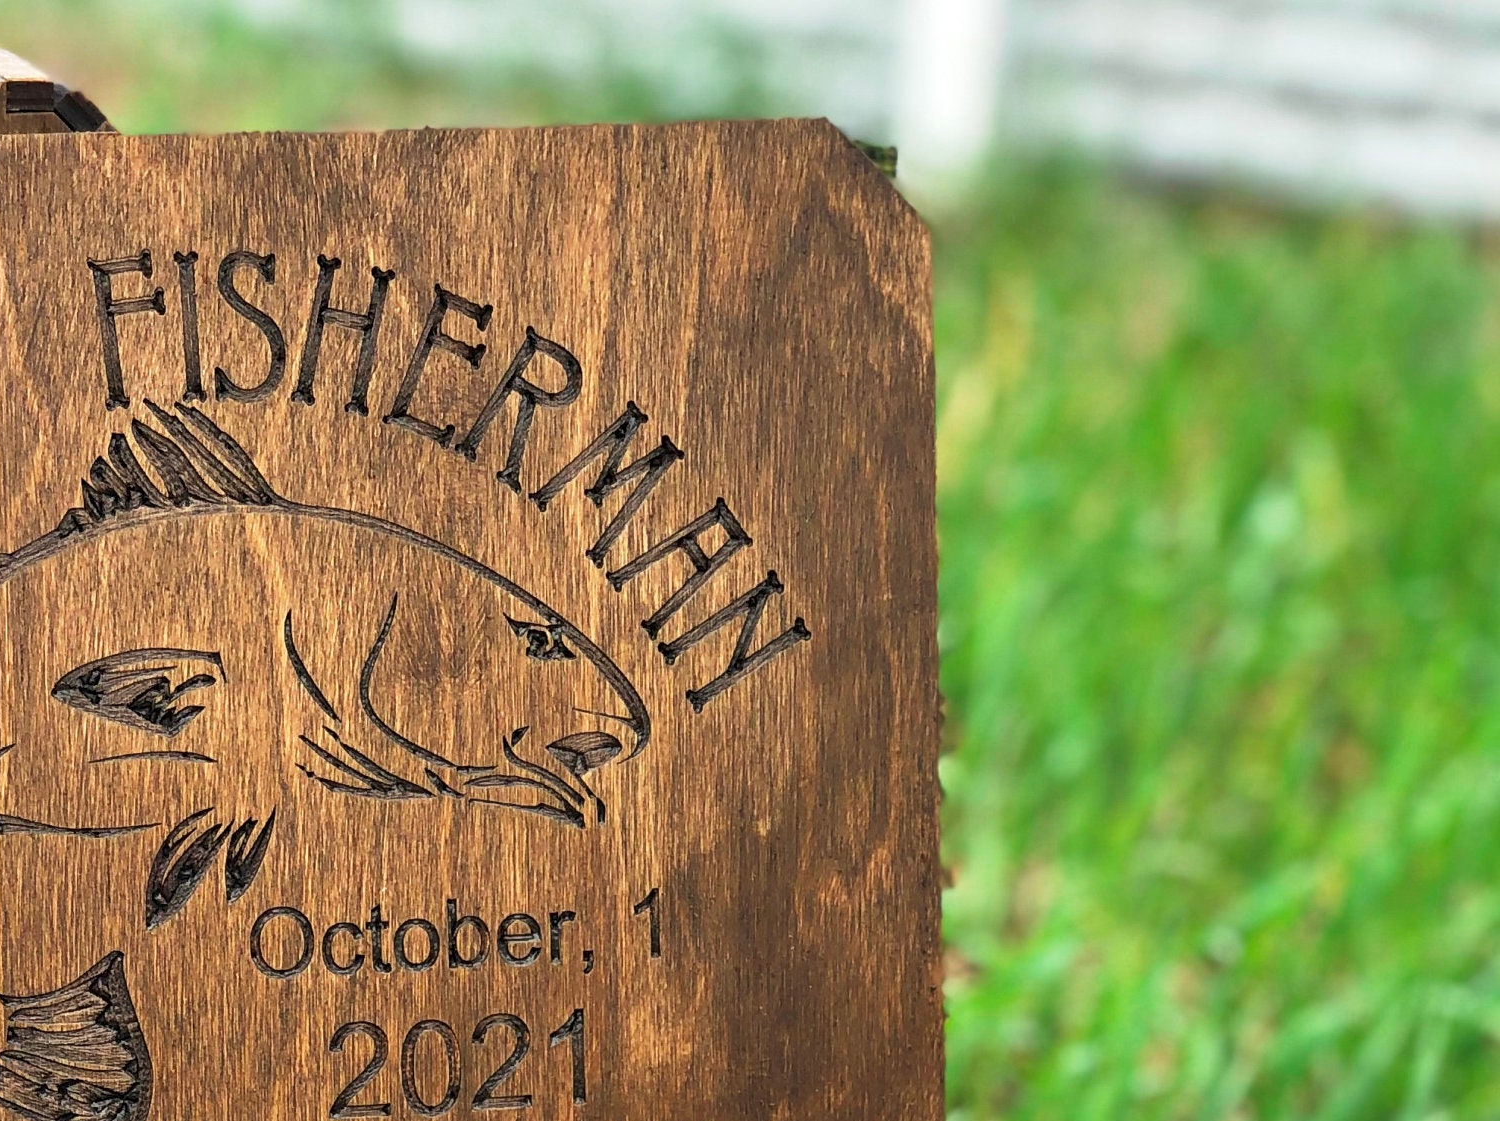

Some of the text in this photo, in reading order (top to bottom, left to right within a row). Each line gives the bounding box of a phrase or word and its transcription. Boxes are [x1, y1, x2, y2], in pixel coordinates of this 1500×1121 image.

[88, 249, 811, 713] FISHERMAN
[249, 887, 663, 980] October, 1
[328, 1008, 589, 1120] 2021
